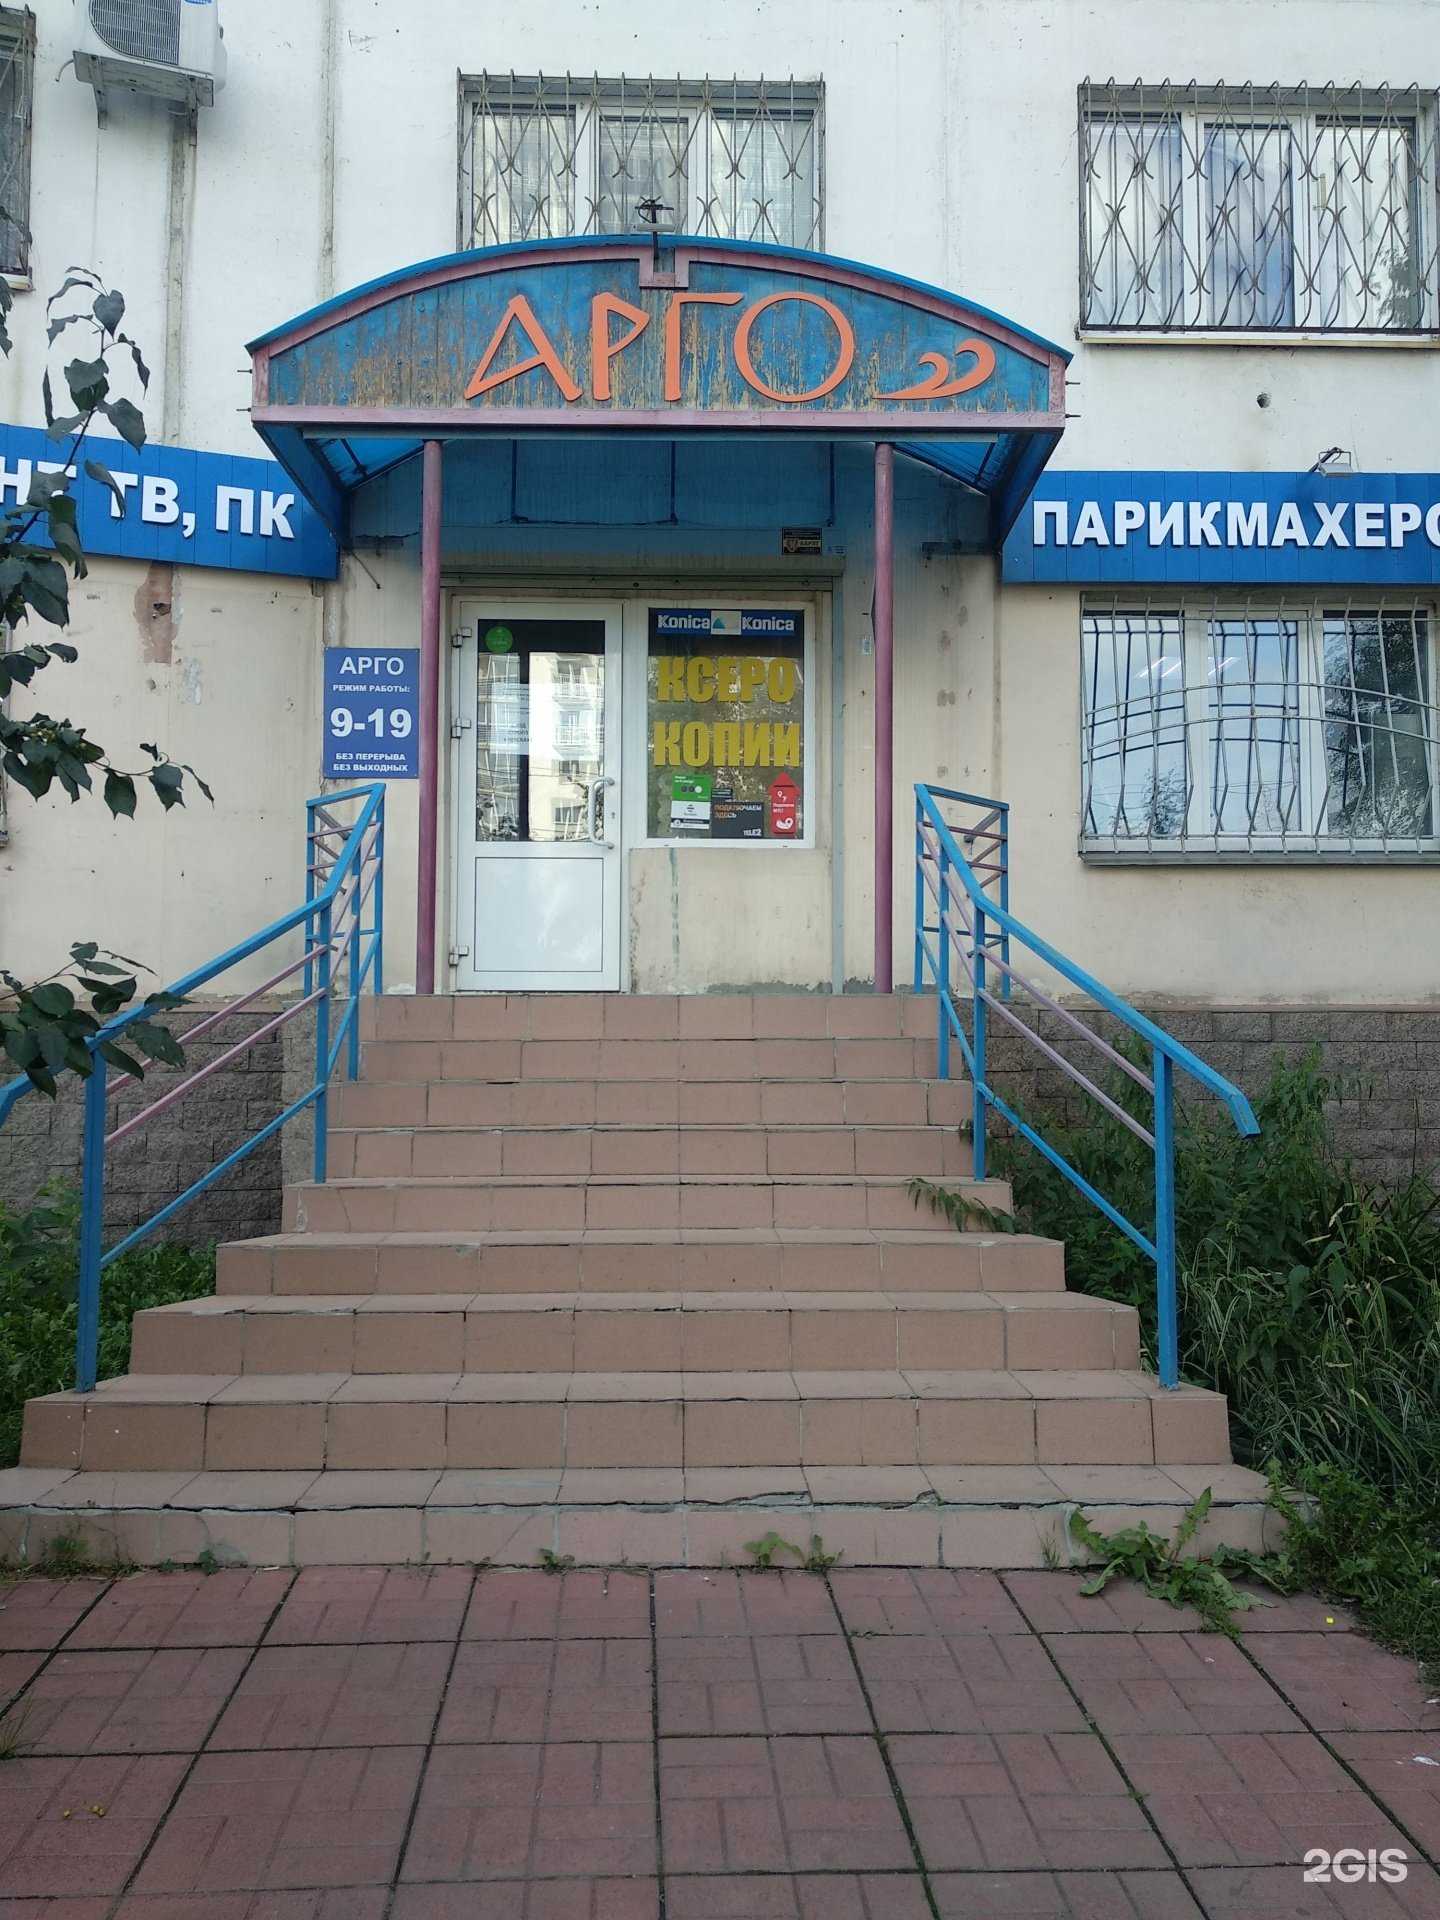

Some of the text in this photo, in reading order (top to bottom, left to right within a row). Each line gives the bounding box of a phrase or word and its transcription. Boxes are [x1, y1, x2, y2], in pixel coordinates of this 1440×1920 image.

[464, 290, 854, 402] АРГО
[108, 470, 196, 538] ТВ,
[215, 485, 295, 538] ПК
[657, 615, 794, 631] Konica Konica
[340, 656, 404, 675] АРГО
[333, 684, 367, 692] РЕЖИМ
[657, 656, 795, 703] КСЕРО
[330, 707, 412, 738] 9-19
[653, 720, 800, 767] КОПИИ
[353, 764, 408, 772] ВЫХОДНЫХ
[356, 753, 405, 761] ПЕРЕРЫВА
